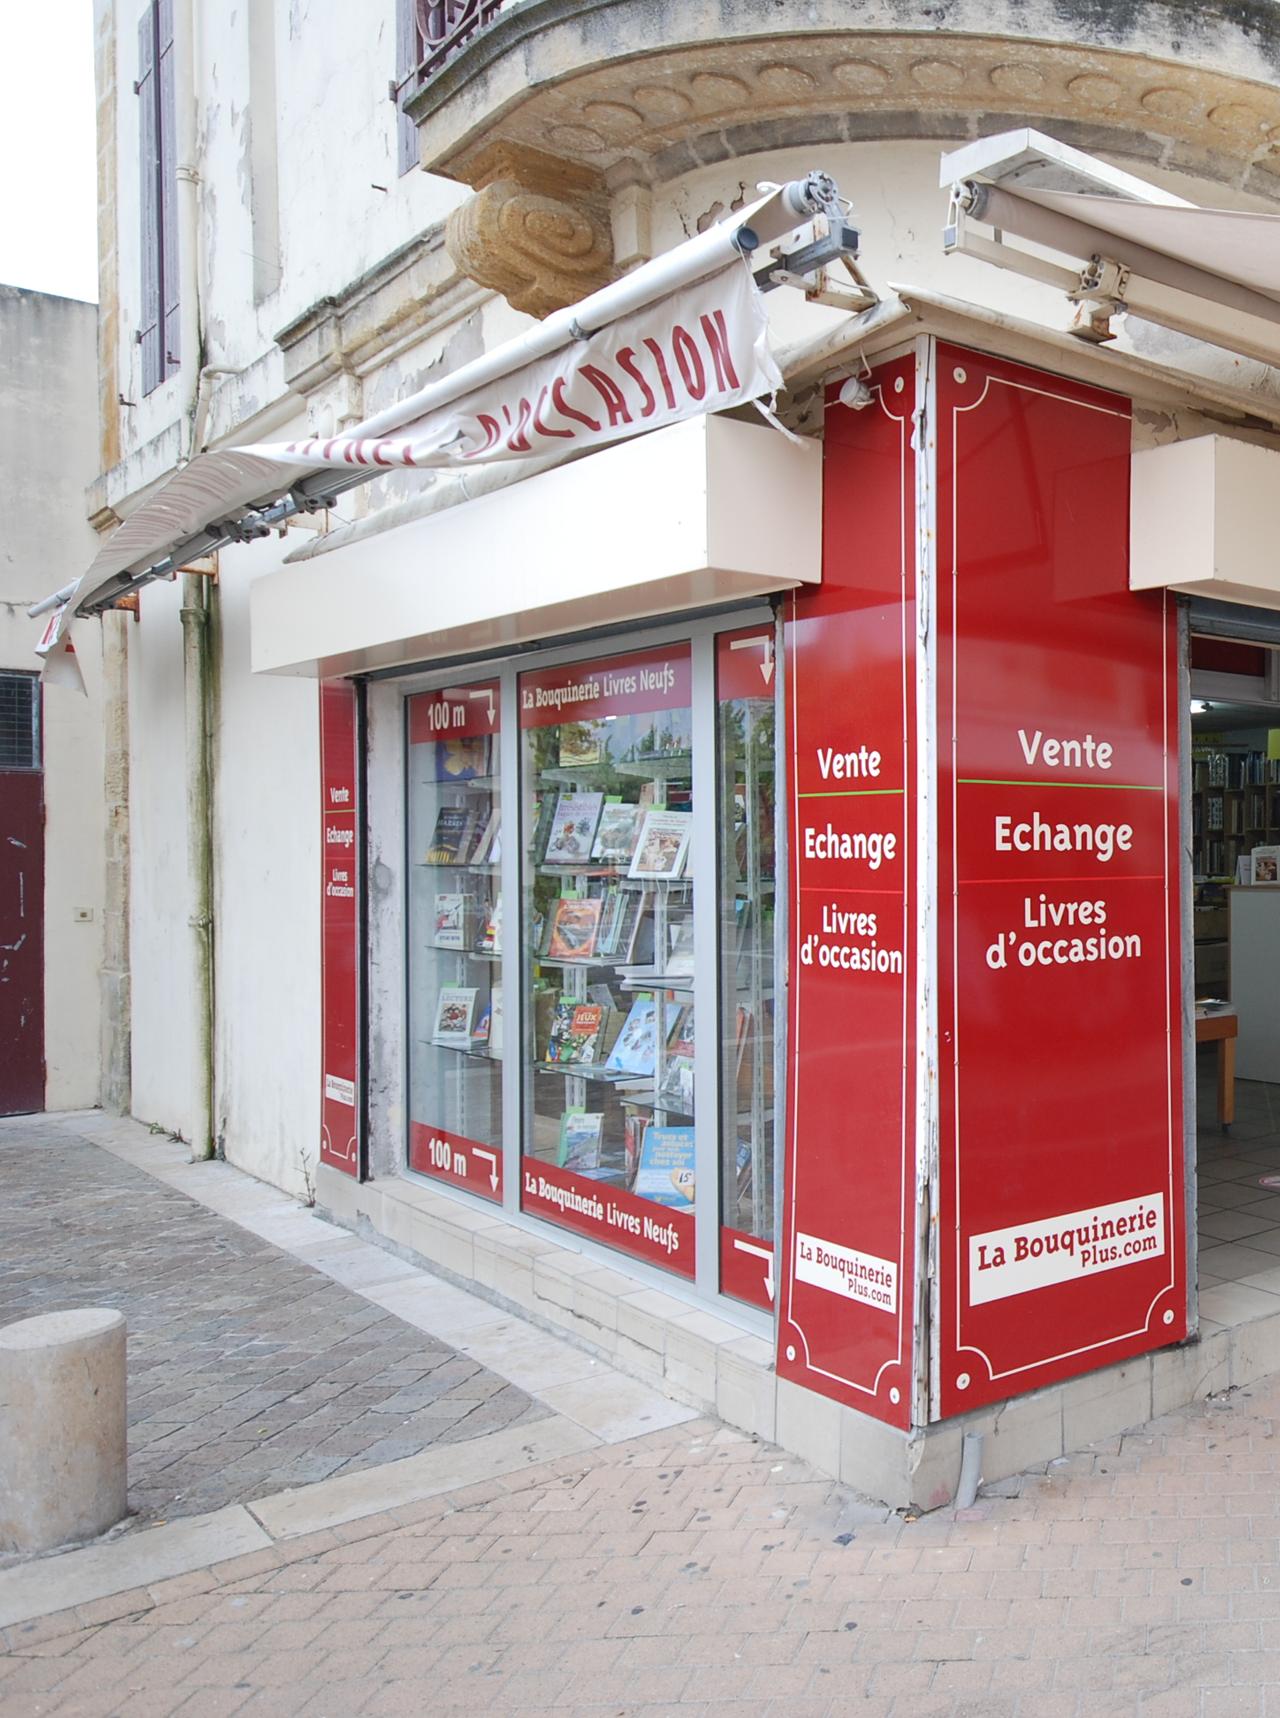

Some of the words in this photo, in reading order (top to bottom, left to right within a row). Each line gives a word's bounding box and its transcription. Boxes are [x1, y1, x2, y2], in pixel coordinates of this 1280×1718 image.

[523, 690, 534, 709] La
[536, 680, 600, 711] Bouquinerie
[603, 673, 637, 697] Livres
[640, 662, 675, 694] Neufs
[427, 703, 450, 731] 100
[453, 704, 465, 727] m
[816, 745, 882, 780] Vente
[1017, 729, 1114, 770] Vente
[330, 786, 350, 803] Vente
[326, 825, 354, 848] Echange
[804, 823, 897, 871] Echange
[995, 811, 1134, 862] Echange
[332, 868, 348, 882] Livres
[822, 903, 878, 936] Livres
[1024, 893, 1108, 928] Livres
[800, 934, 903, 974] d'occasion
[985, 927, 1142, 970] d'occasion
[428, 1137, 451, 1171] 100
[453, 1152, 467, 1178] m
[525, 1172, 537, 1192] La
[538, 1175, 604, 1221] Bouquinerie
[606, 1202, 641, 1235] Livres
[643, 1215, 680, 1254] Neufs
[977, 1244, 1006, 1272] La
[1014, 1204, 1157, 1262] Bouquinerie
[1081, 1233, 1158, 1269] Plus.com
[800, 1242, 813, 1263] La
[816, 1247, 893, 1289] Bouquinerie
[848, 1279, 892, 1306] Plus.com
